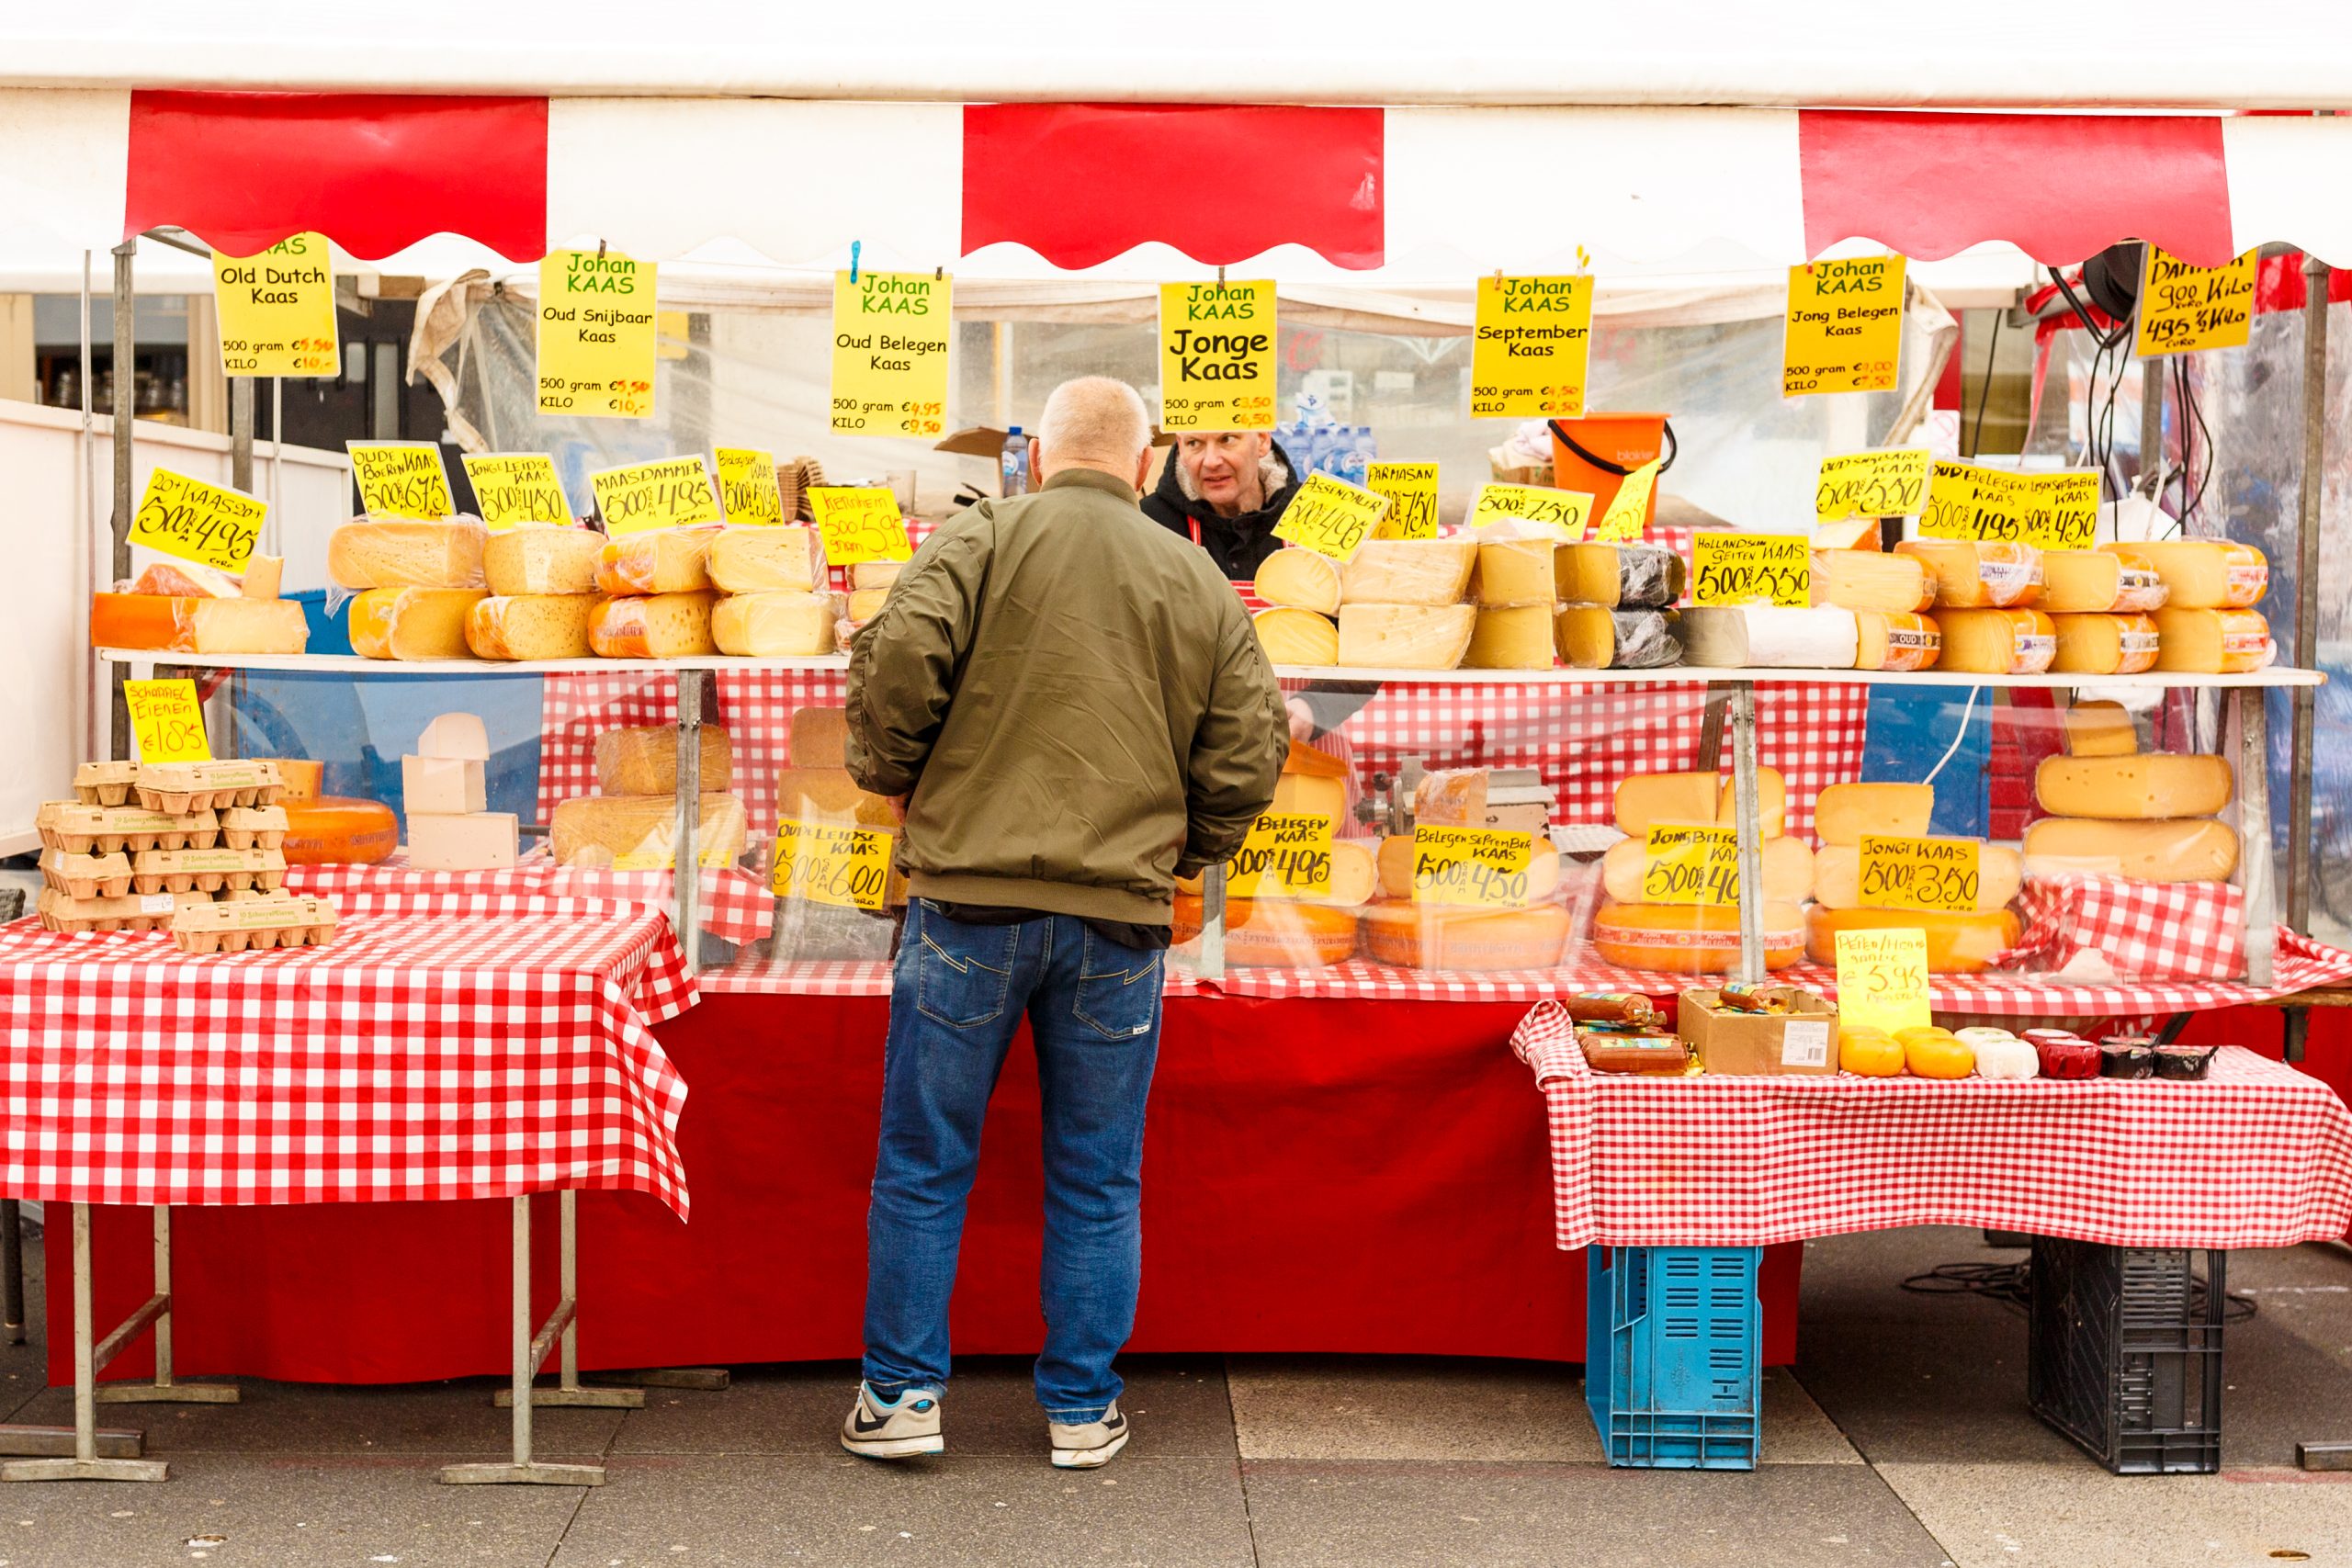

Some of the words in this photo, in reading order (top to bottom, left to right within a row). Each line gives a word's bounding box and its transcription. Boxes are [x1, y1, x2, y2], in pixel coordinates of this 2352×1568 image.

[567, 254, 636, 274] Johan
[1816, 261, 1883, 278] Johan
[221, 267, 255, 284] Old
[266, 267, 325, 284] Dutch
[568, 275, 635, 294] KAAS
[862, 275, 930, 295] Johan
[1187, 284, 1255, 302] Johan
[1504, 278, 1572, 296] Johan
[1816, 276, 1883, 296] KAAS
[252, 288, 298, 304] Kaas
[1504, 297, 1570, 312] KAAS
[863, 296, 929, 315] KAAS
[1189, 303, 1254, 321] KAAS
[544, 308, 576, 321] Oud
[583, 309, 652, 326] Snijbaar
[1792, 310, 1829, 323] Jong
[1838, 306, 1898, 321] Belegen
[579, 329, 616, 343] Kaas
[1477, 324, 1588, 344] September
[1826, 325, 1862, 337] Kaas
[223, 341, 247, 351] 500
[254, 344, 284, 354] gram
[837, 334, 872, 348] Oud
[880, 335, 947, 355] Belegen
[1170, 330, 1268, 360] Jonge
[1509, 343, 1554, 356] Kaas
[225, 359, 257, 368] KILO
[871, 355, 910, 370] Kaas
[1182, 356, 1258, 382] Kaas
[1786, 367, 1810, 377] 500
[1815, 366, 1846, 377] gram
[540, 378, 564, 389] 500
[571, 381, 602, 392] gram
[1474, 387, 1497, 396] 500
[1503, 389, 1532, 398] gram
[1786, 380, 1817, 391] KILO
[540, 397, 573, 408] KILO
[833, 399, 857, 410] 500
[863, 402, 894, 413] gram
[1165, 399, 1188, 409] 500
[1194, 400, 1224, 411] gram
[1473, 402, 1505, 412] KILO
[832, 417, 865, 428] KILO
[1165, 415, 1197, 425] KILO
[605, 490, 647, 524] 500
[825, 513, 858, 536] 500
[1899, 635, 1917, 644] OUD
[1472, 848, 1517, 861] KAAS
[1917, 842, 1968, 861] KAAS
[774, 849, 821, 886] 500
[1415, 852, 1462, 890] 500
[1646, 860, 1699, 897] 500
[1863, 860, 1910, 896] 500
